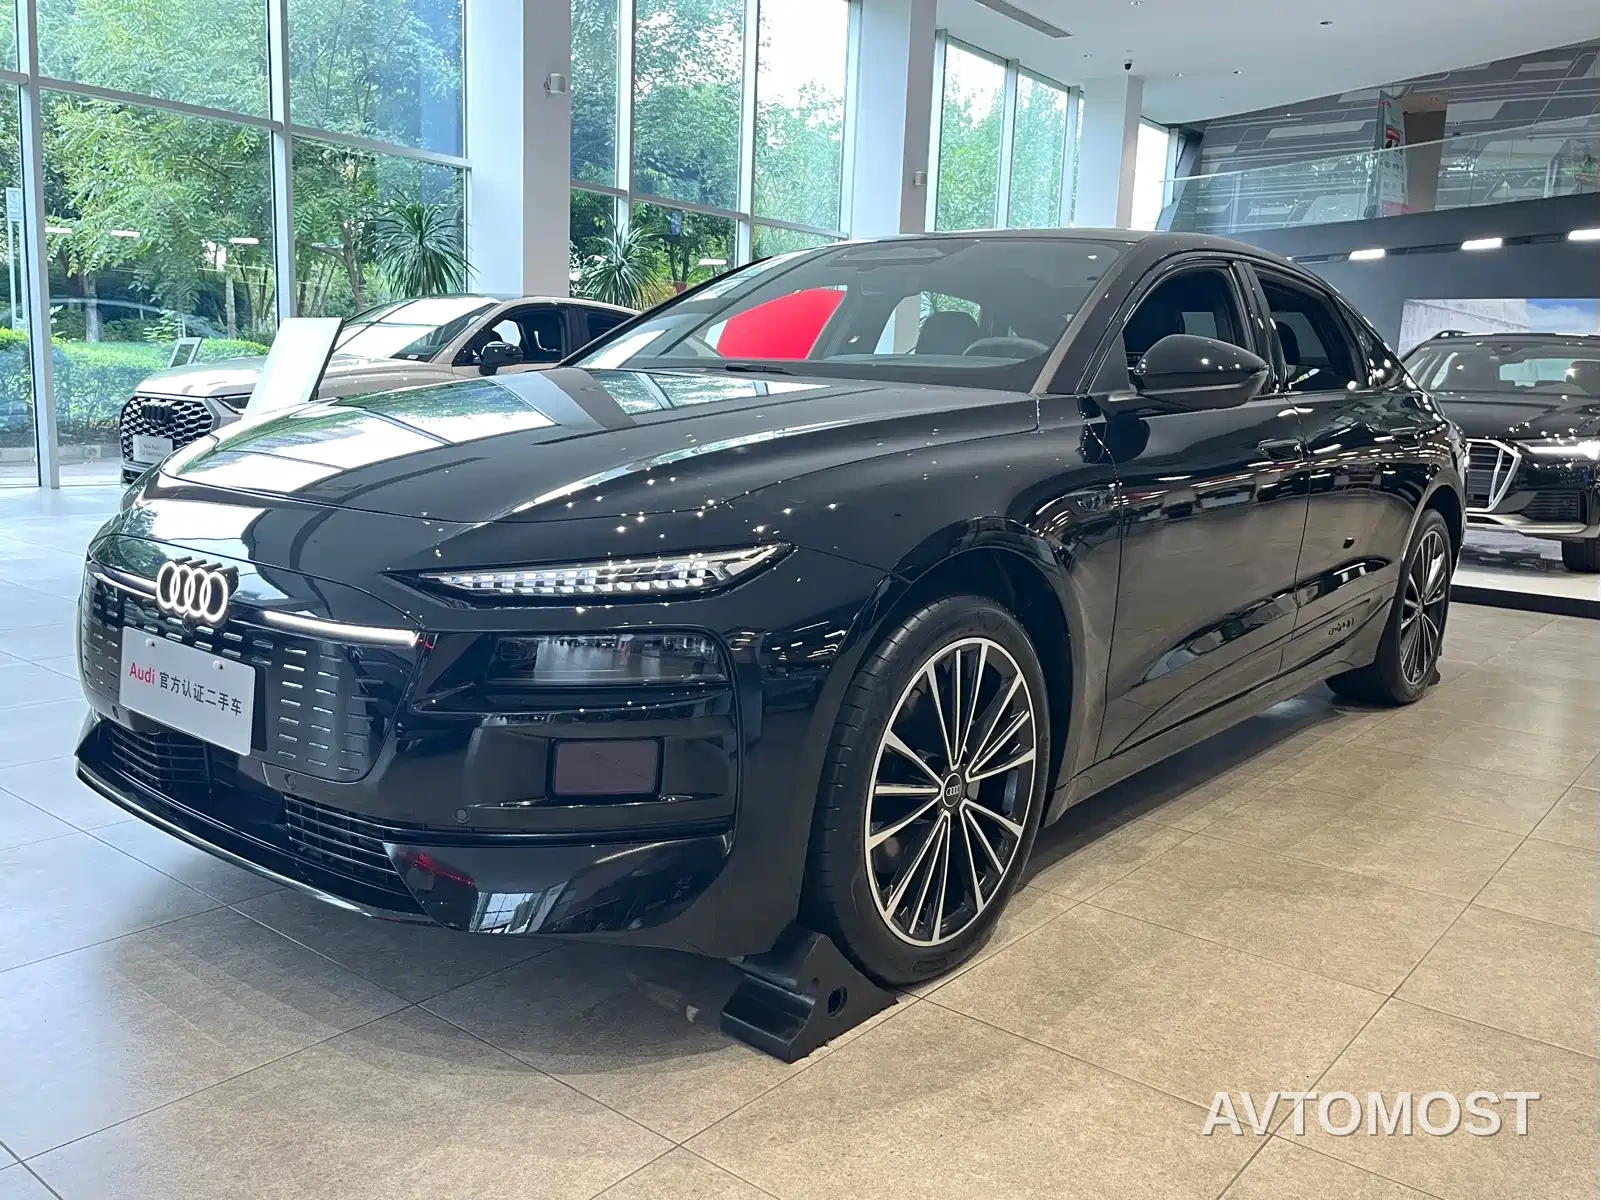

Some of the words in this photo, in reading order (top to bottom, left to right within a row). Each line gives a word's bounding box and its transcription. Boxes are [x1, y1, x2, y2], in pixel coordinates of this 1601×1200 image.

[129, 662, 155, 685] Audi
[159, 672, 242, 715] 官方认证二手车
